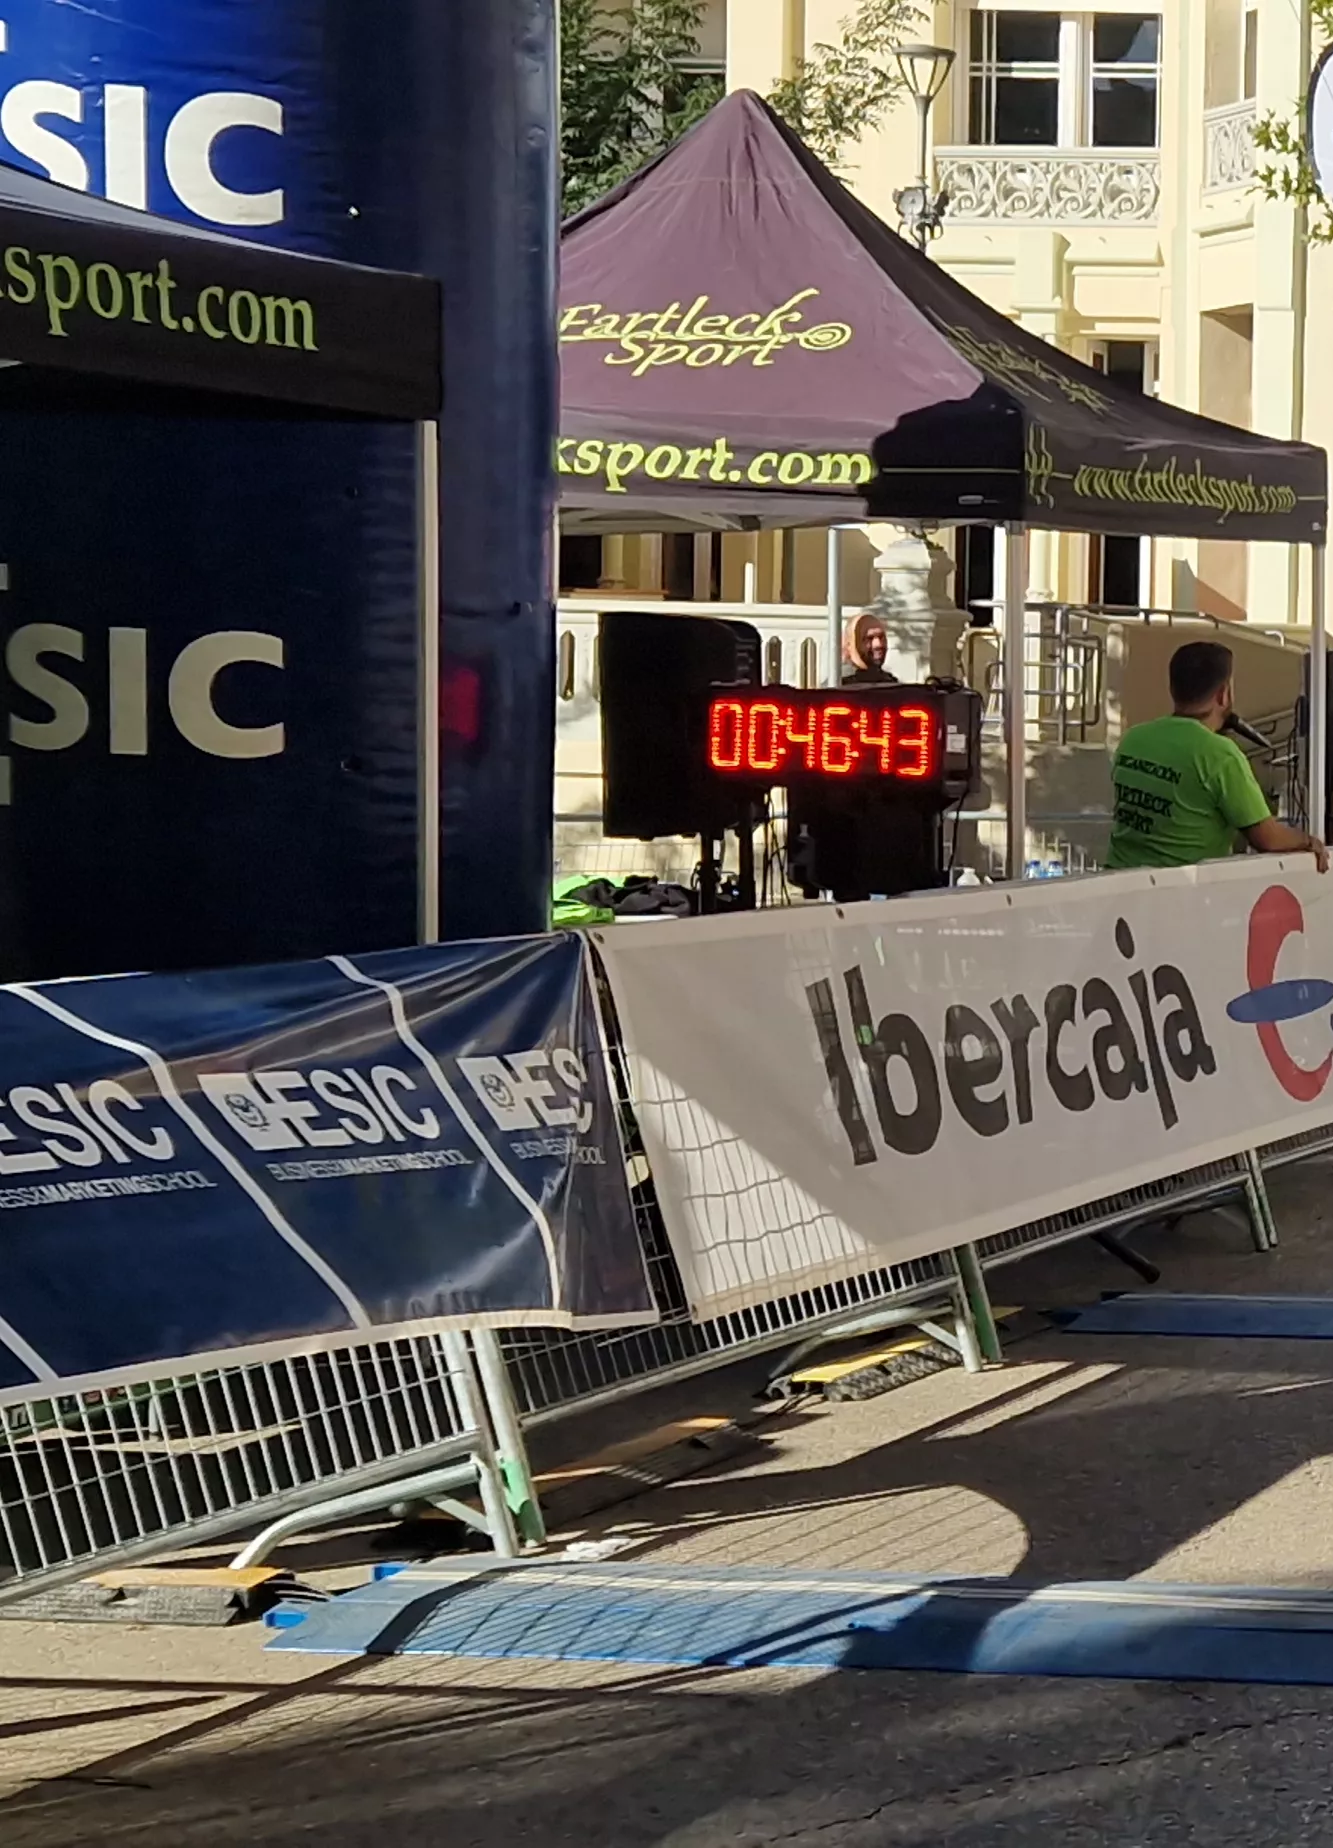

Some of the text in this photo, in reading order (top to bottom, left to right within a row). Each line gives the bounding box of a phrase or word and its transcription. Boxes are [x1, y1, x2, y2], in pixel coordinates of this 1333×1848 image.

[0, 80, 285, 226] SIC
[0, 246, 319, 352] sport.com
[559, 288, 820, 341] Fartleck
[603, 331, 785, 377] Sport
[0, 622, 286, 758] SIC
[711, 702, 930, 777] 00:46:43
[805, 916, 1216, 1166] Ibercaja
[253, 1065, 441, 1148] ESIC
